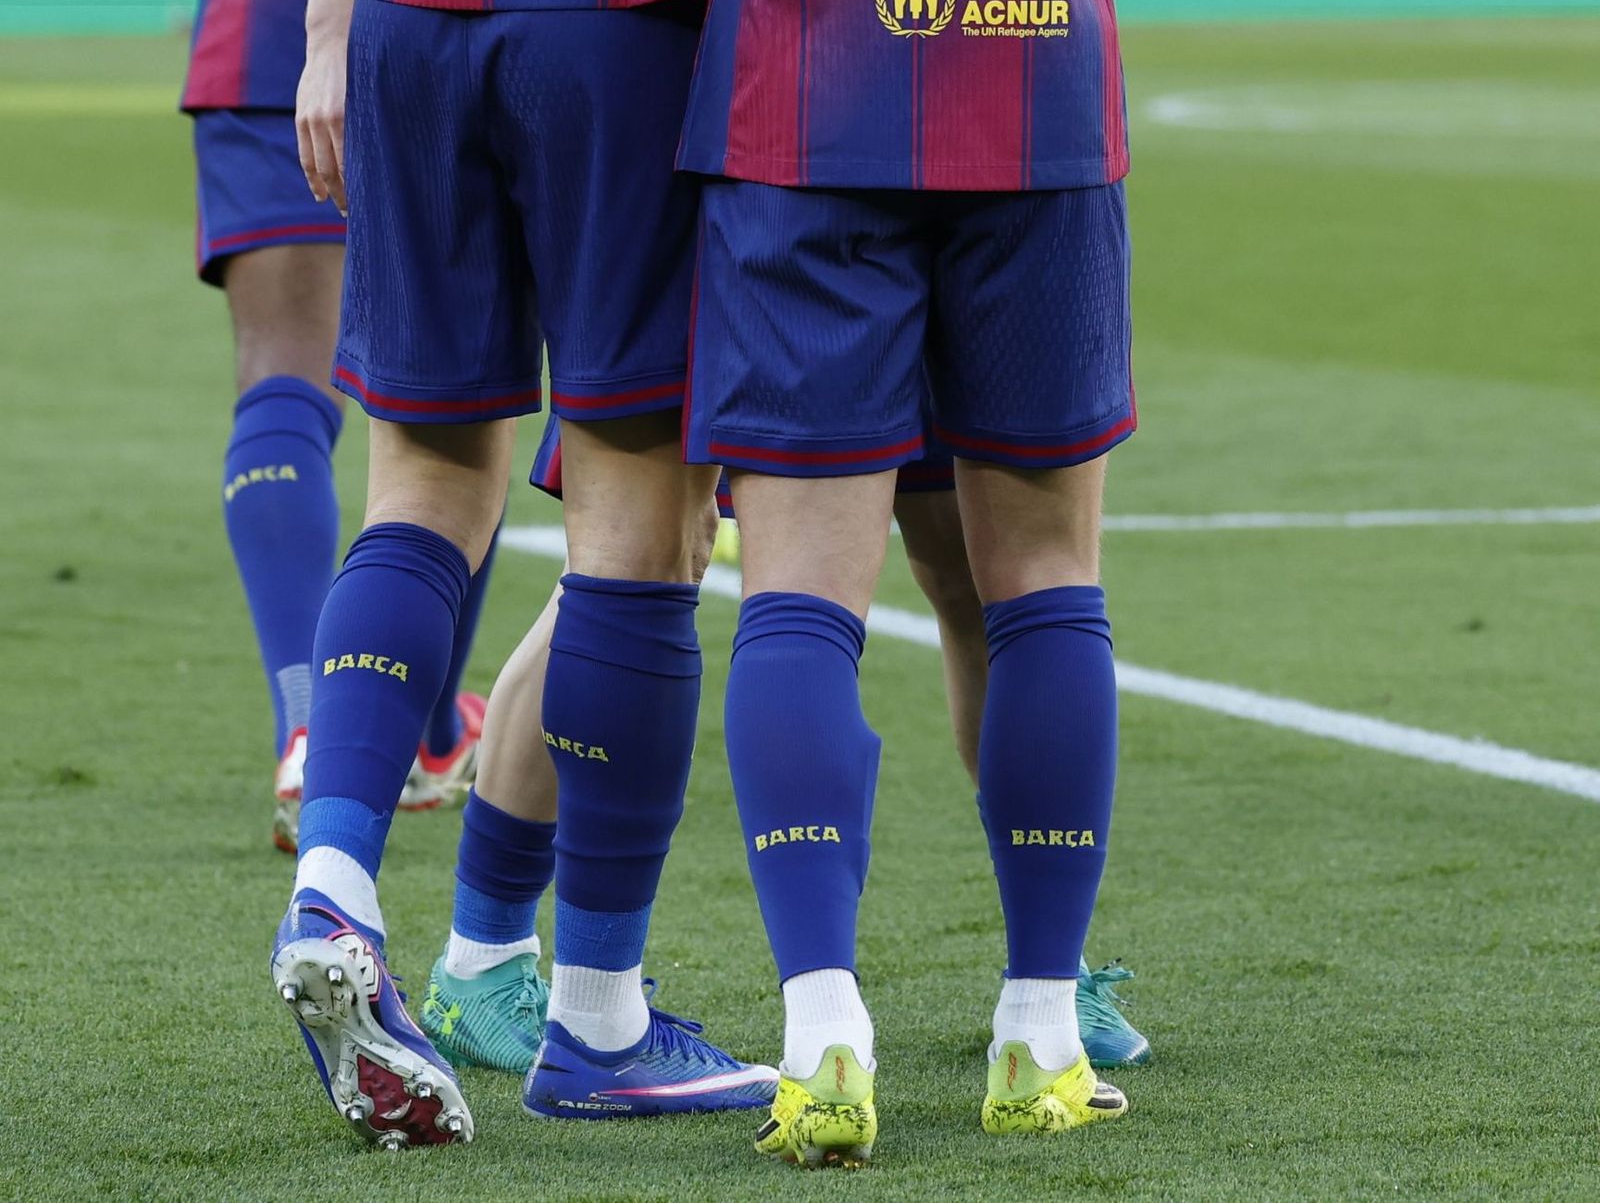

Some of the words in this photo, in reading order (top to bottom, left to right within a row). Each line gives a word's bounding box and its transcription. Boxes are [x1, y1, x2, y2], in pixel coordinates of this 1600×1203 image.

[961, 0, 1069, 25] ACNUR
[962, 27, 980, 36] The
[981, 27, 996, 36] UN
[998, 27, 1036, 38] Refugee
[1037, 27, 1068, 38] Agency
[324, 653, 408, 682] BARÇA
[542, 727, 609, 763] ARÇA
[755, 825, 840, 852] BARÇA
[1011, 829, 1094, 848] BARÇA
